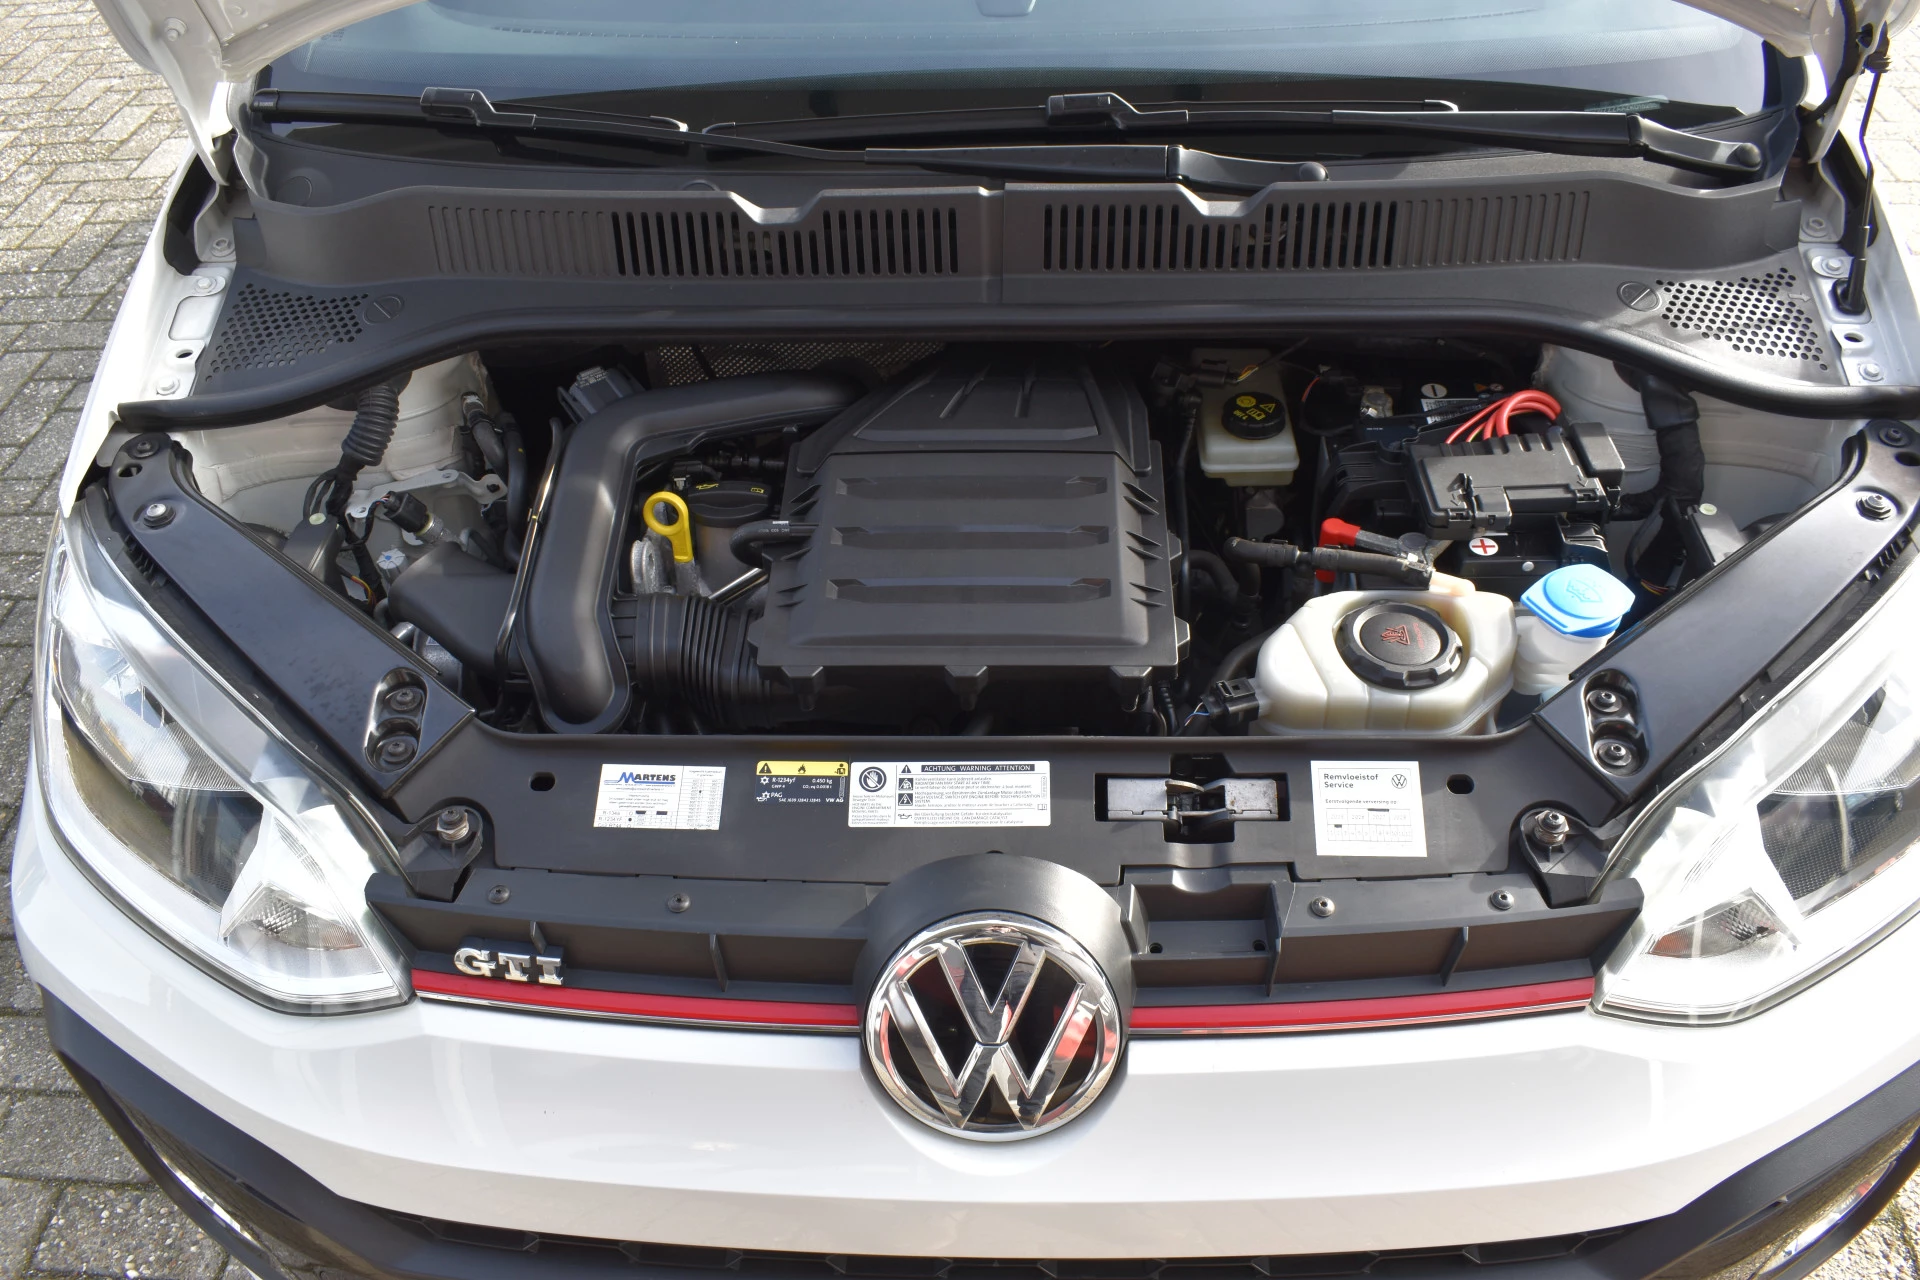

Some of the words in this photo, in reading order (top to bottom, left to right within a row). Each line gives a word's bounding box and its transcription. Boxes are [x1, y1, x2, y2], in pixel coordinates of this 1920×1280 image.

[619, 771, 676, 784] MARTENS
[454, 947, 564, 985] GTI
[874, 930, 1112, 1135] VW
